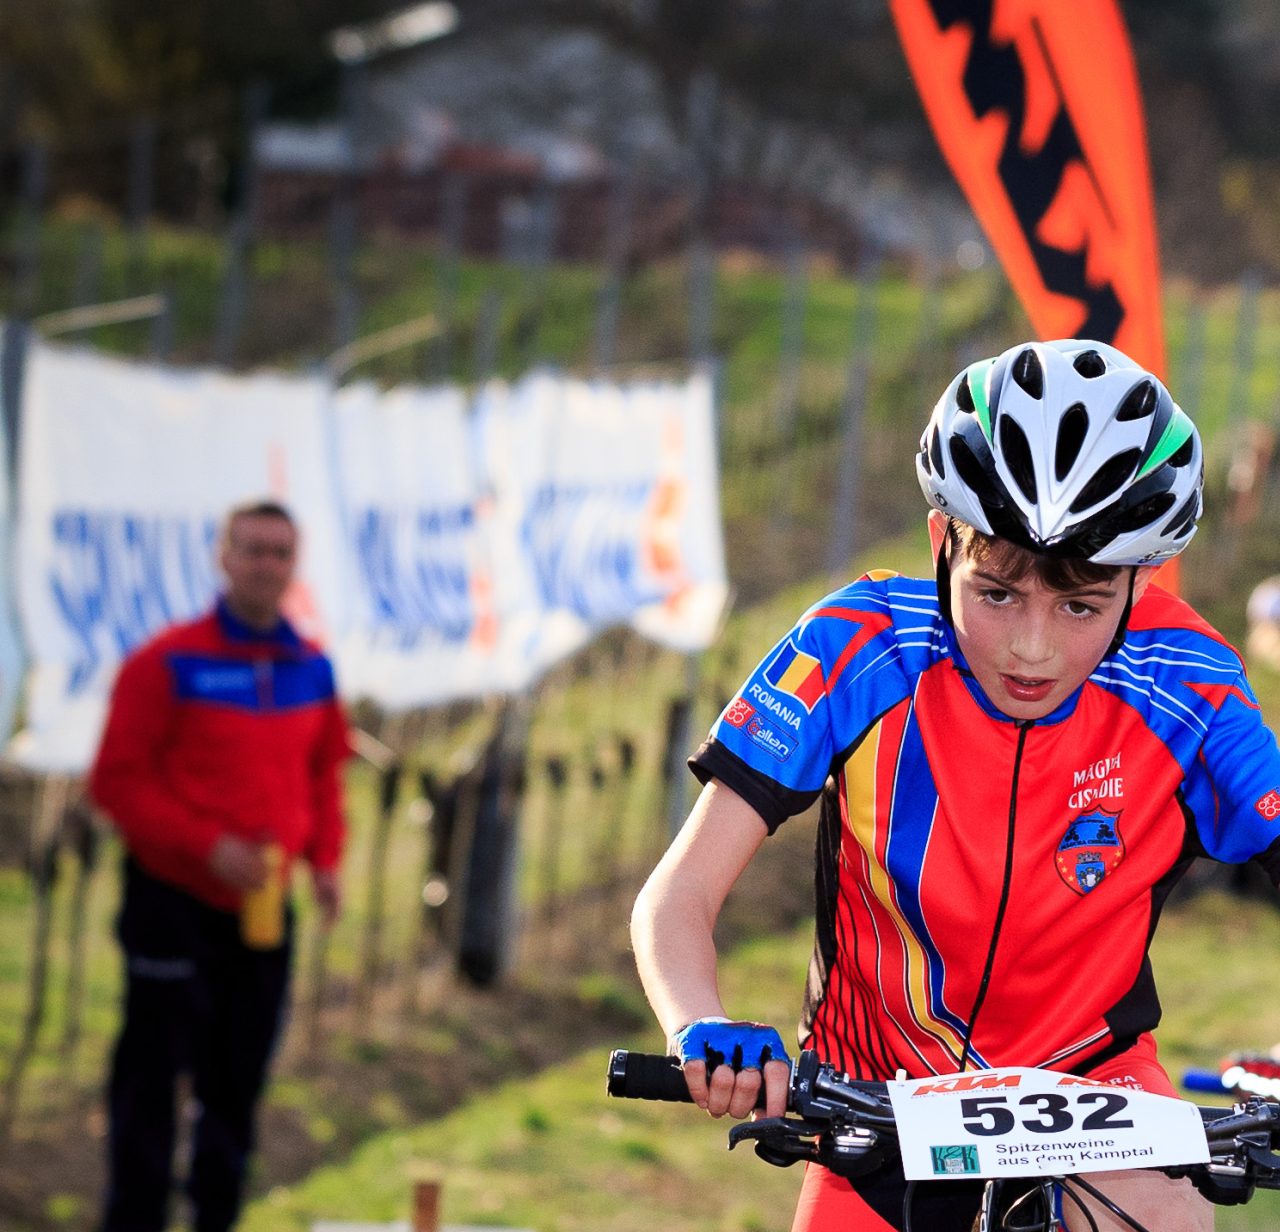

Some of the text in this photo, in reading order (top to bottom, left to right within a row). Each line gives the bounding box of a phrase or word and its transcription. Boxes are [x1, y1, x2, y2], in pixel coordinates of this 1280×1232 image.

[912, 1073, 1022, 1096] KTM
[960, 1092, 1135, 1137] 532
[995, 1138, 1116, 1155] Spitzenweine
[997, 1156, 1030, 1166] aus
[1080, 1146, 1155, 1160] Kamptal
